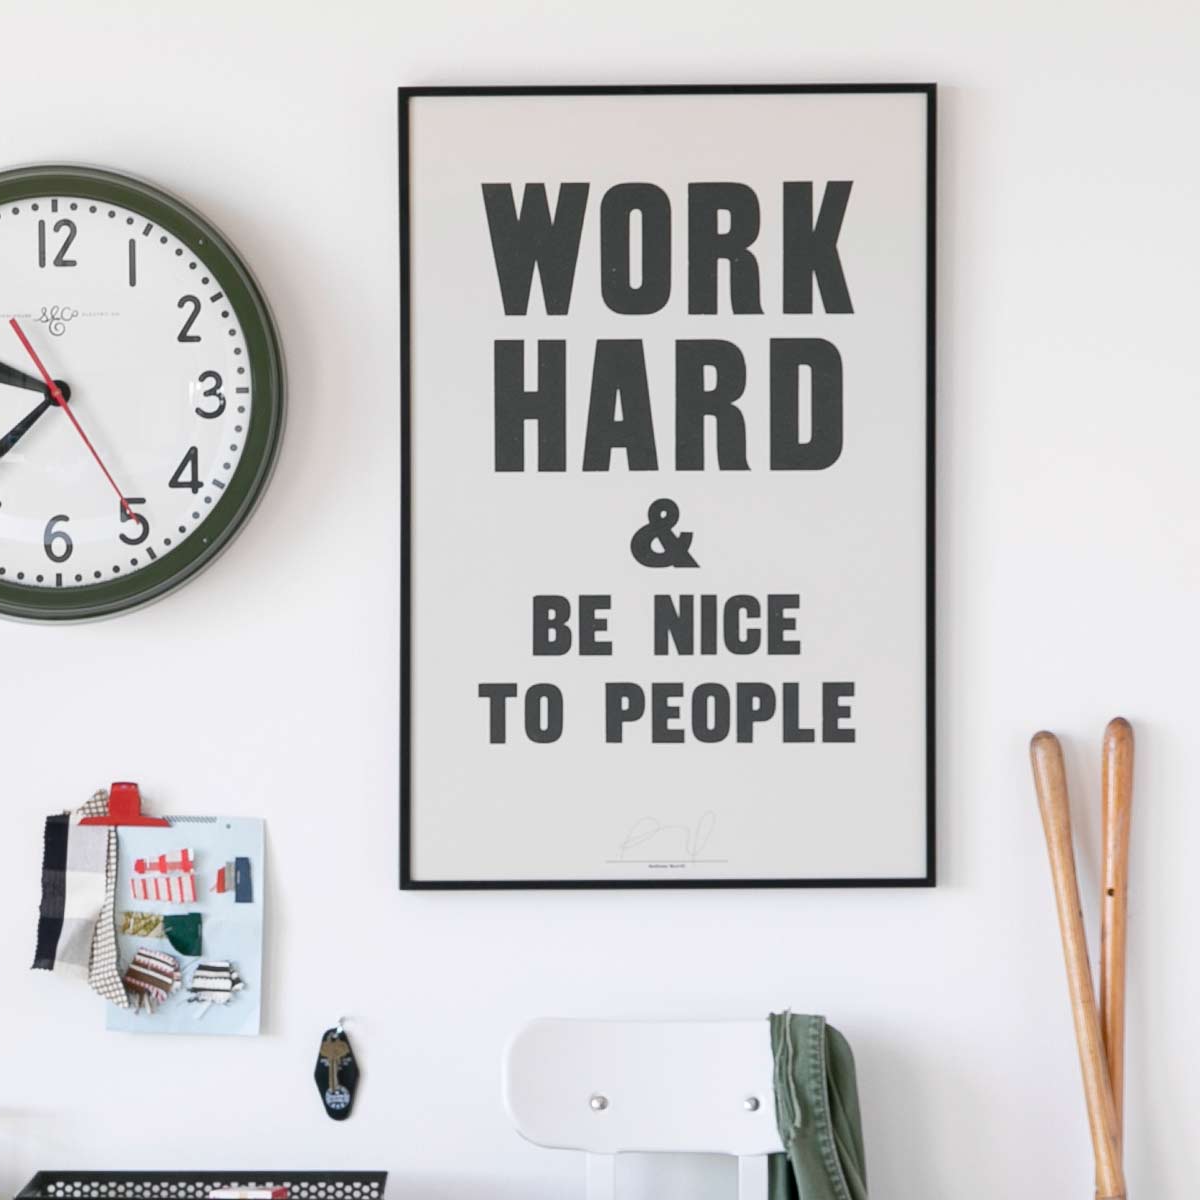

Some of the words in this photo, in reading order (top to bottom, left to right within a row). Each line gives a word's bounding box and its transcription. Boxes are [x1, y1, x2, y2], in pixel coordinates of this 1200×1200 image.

[39, 219, 77, 268] 12
[129, 239, 137, 287] 1
[482, 181, 855, 316] WORK
[178, 295, 202, 343] 2
[195, 370, 226, 420] 3
[494, 338, 844, 473] HARD
[168, 446, 204, 495] 4
[43, 515, 74, 563] 6
[119, 497, 150, 546] 5
[631, 499, 700, 569] &
[533, 595, 613, 656] BE
[655, 594, 801, 656] NICE
[479, 683, 564, 744] TO
[606, 682, 856, 744] PEOPLE
